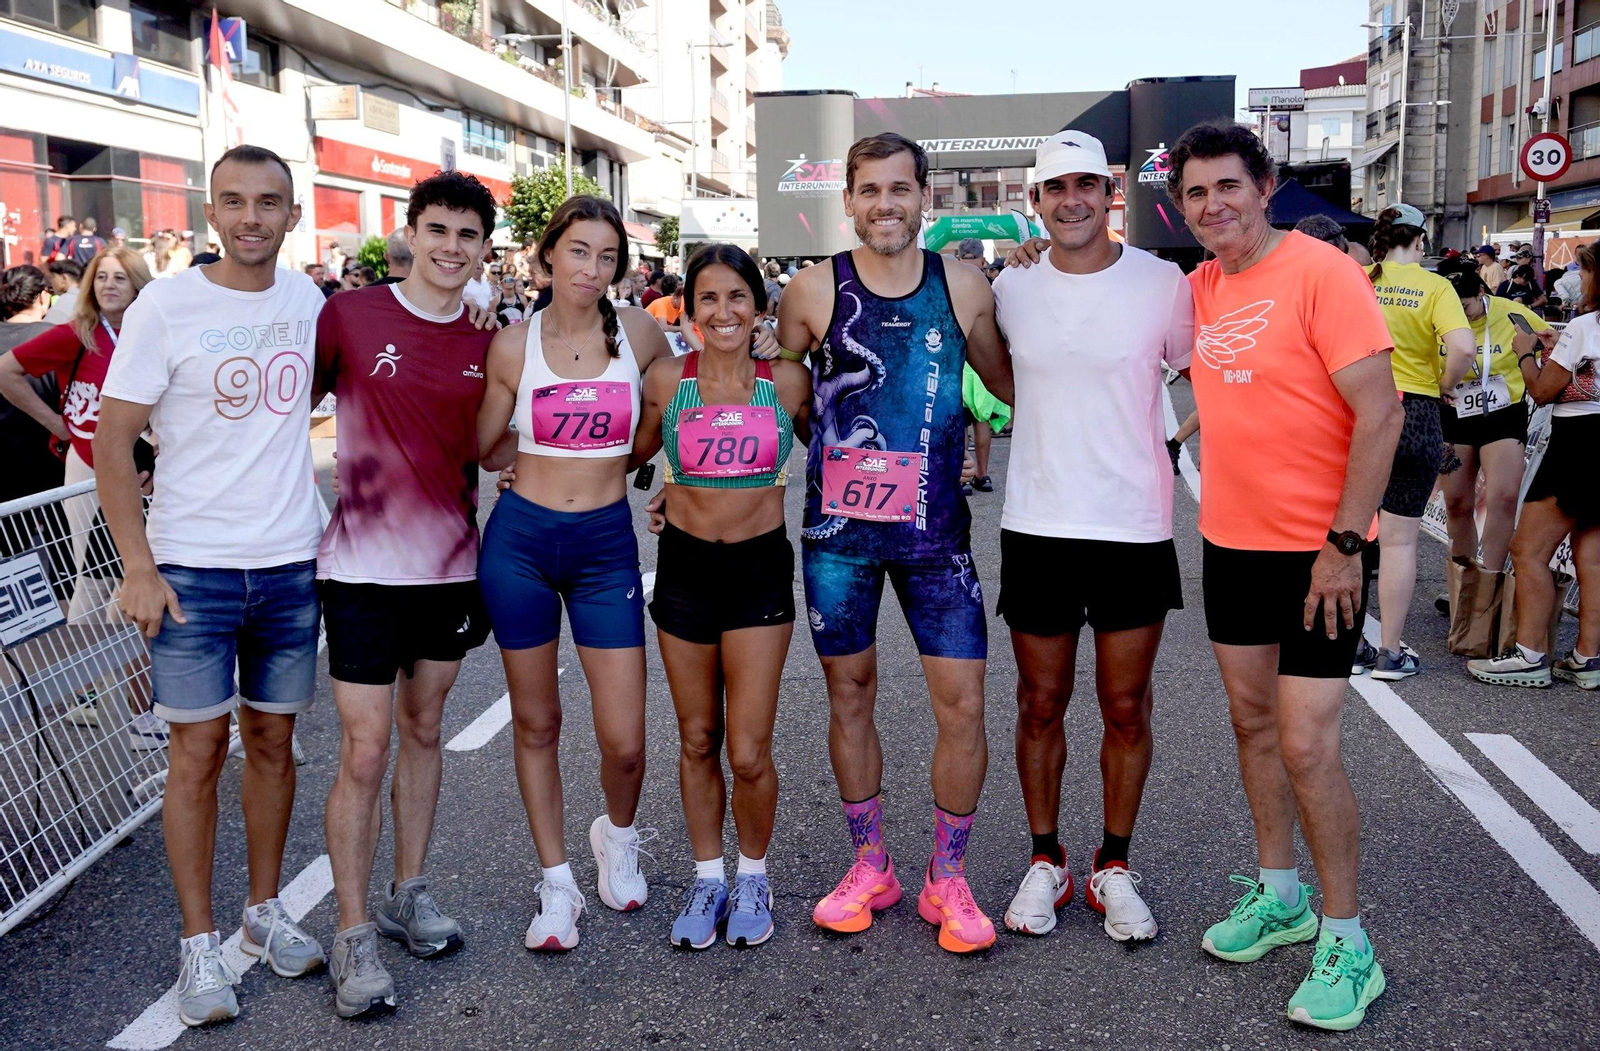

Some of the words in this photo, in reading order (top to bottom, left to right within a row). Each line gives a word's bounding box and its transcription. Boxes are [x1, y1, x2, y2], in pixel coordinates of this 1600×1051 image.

[24, 58, 49, 75] AXA
[49, 64, 91, 85] SEGUROS
[1271, 95, 1303, 104] Manolo
[1531, 149, 1561, 166] 30
[795, 163, 843, 182] CAE
[781, 182, 845, 190] INTERRUNNING
[1384, 285, 1424, 297] solidaria
[1396, 298, 1419, 309] 2025
[199, 322, 291, 353] CORE
[462, 369, 484, 379] amura
[213, 351, 309, 421] 90
[572, 388, 597, 397] CAE
[718, 412, 743, 421] CAE
[550, 411, 612, 440] 778
[696, 435, 760, 467] 780
[862, 457, 887, 468] CAE
[915, 427, 931, 532] SERVISUB
[842, 479, 898, 510] 617
